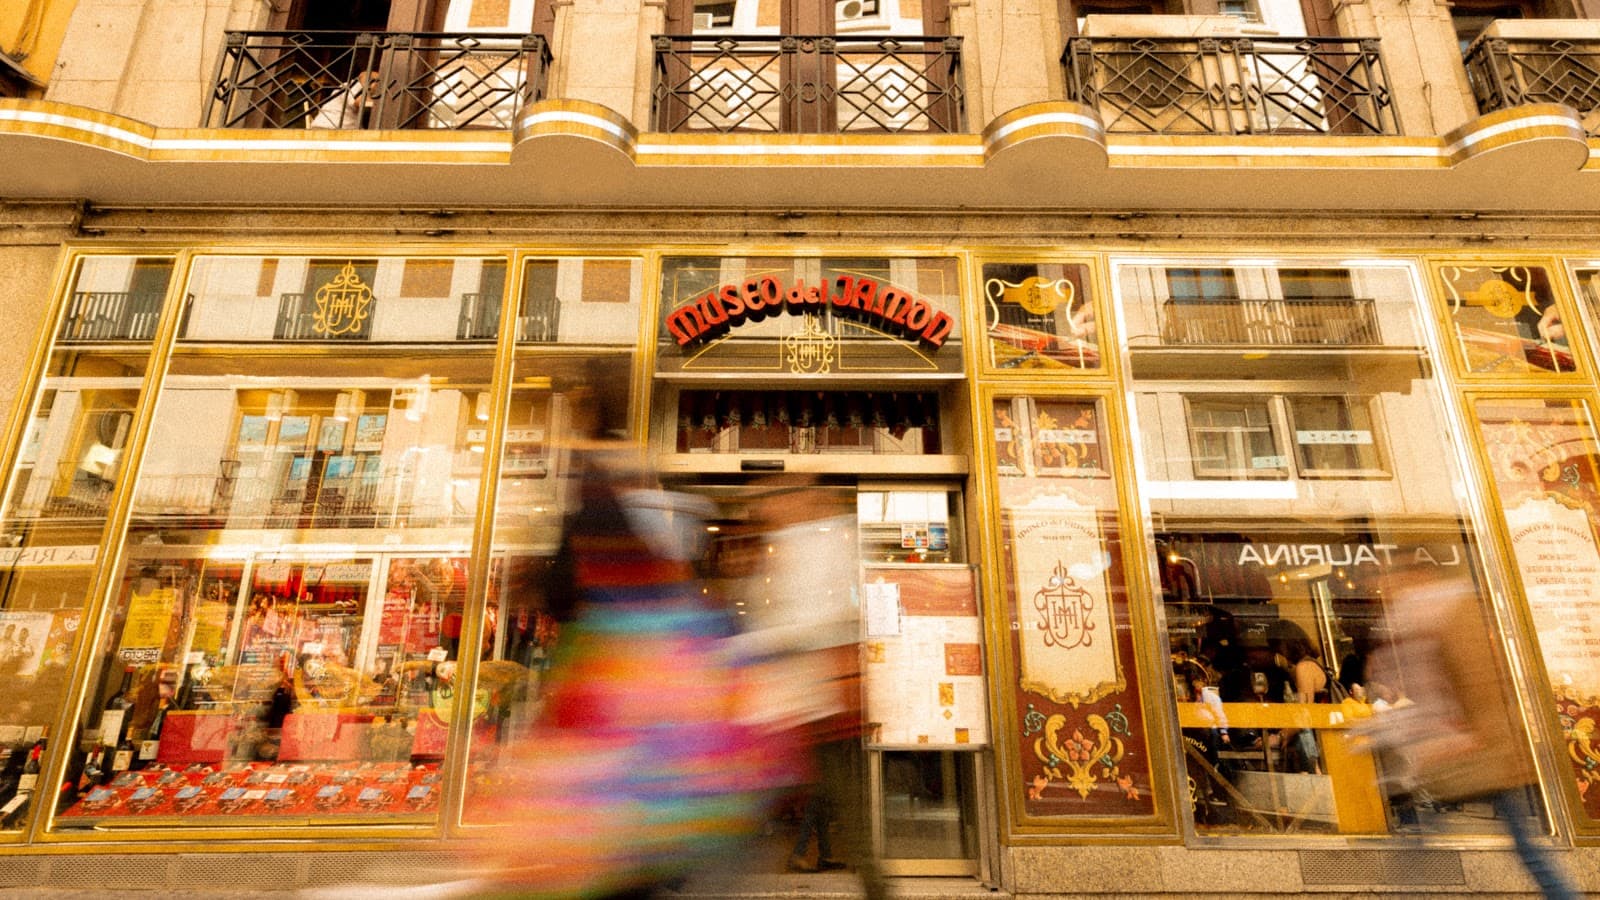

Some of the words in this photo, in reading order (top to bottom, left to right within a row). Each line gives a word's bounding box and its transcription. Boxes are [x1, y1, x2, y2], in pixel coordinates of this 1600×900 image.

[666, 275, 783, 345] MUSEO
[786, 279, 829, 304] del
[832, 275, 954, 346] JAMON
